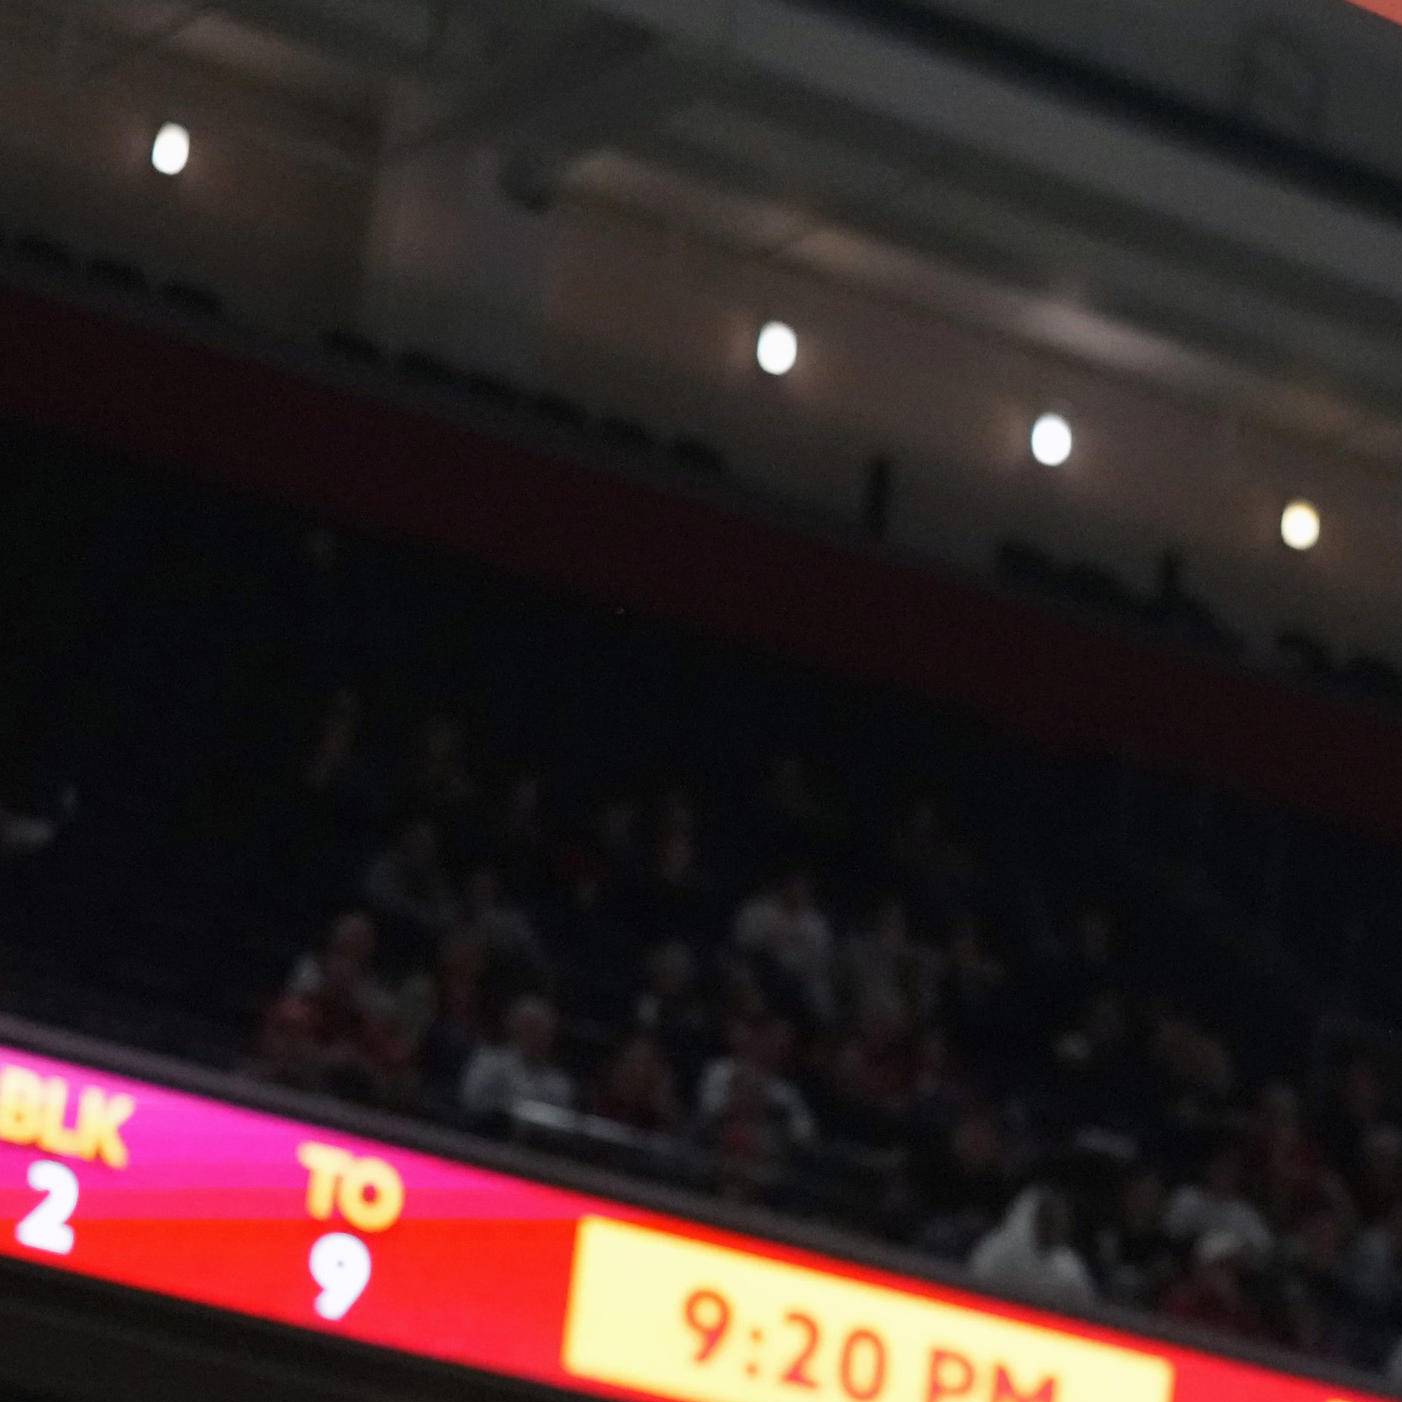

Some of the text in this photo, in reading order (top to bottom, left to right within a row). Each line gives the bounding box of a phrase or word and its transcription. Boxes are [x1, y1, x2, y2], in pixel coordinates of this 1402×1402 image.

[0, 1064, 134, 1168] BLK
[15, 1160, 80, 1255] 2
[297, 1141, 405, 1232] TO
[308, 1232, 372, 1320] 9
[681, 1289, 887, 1402] 9:20
